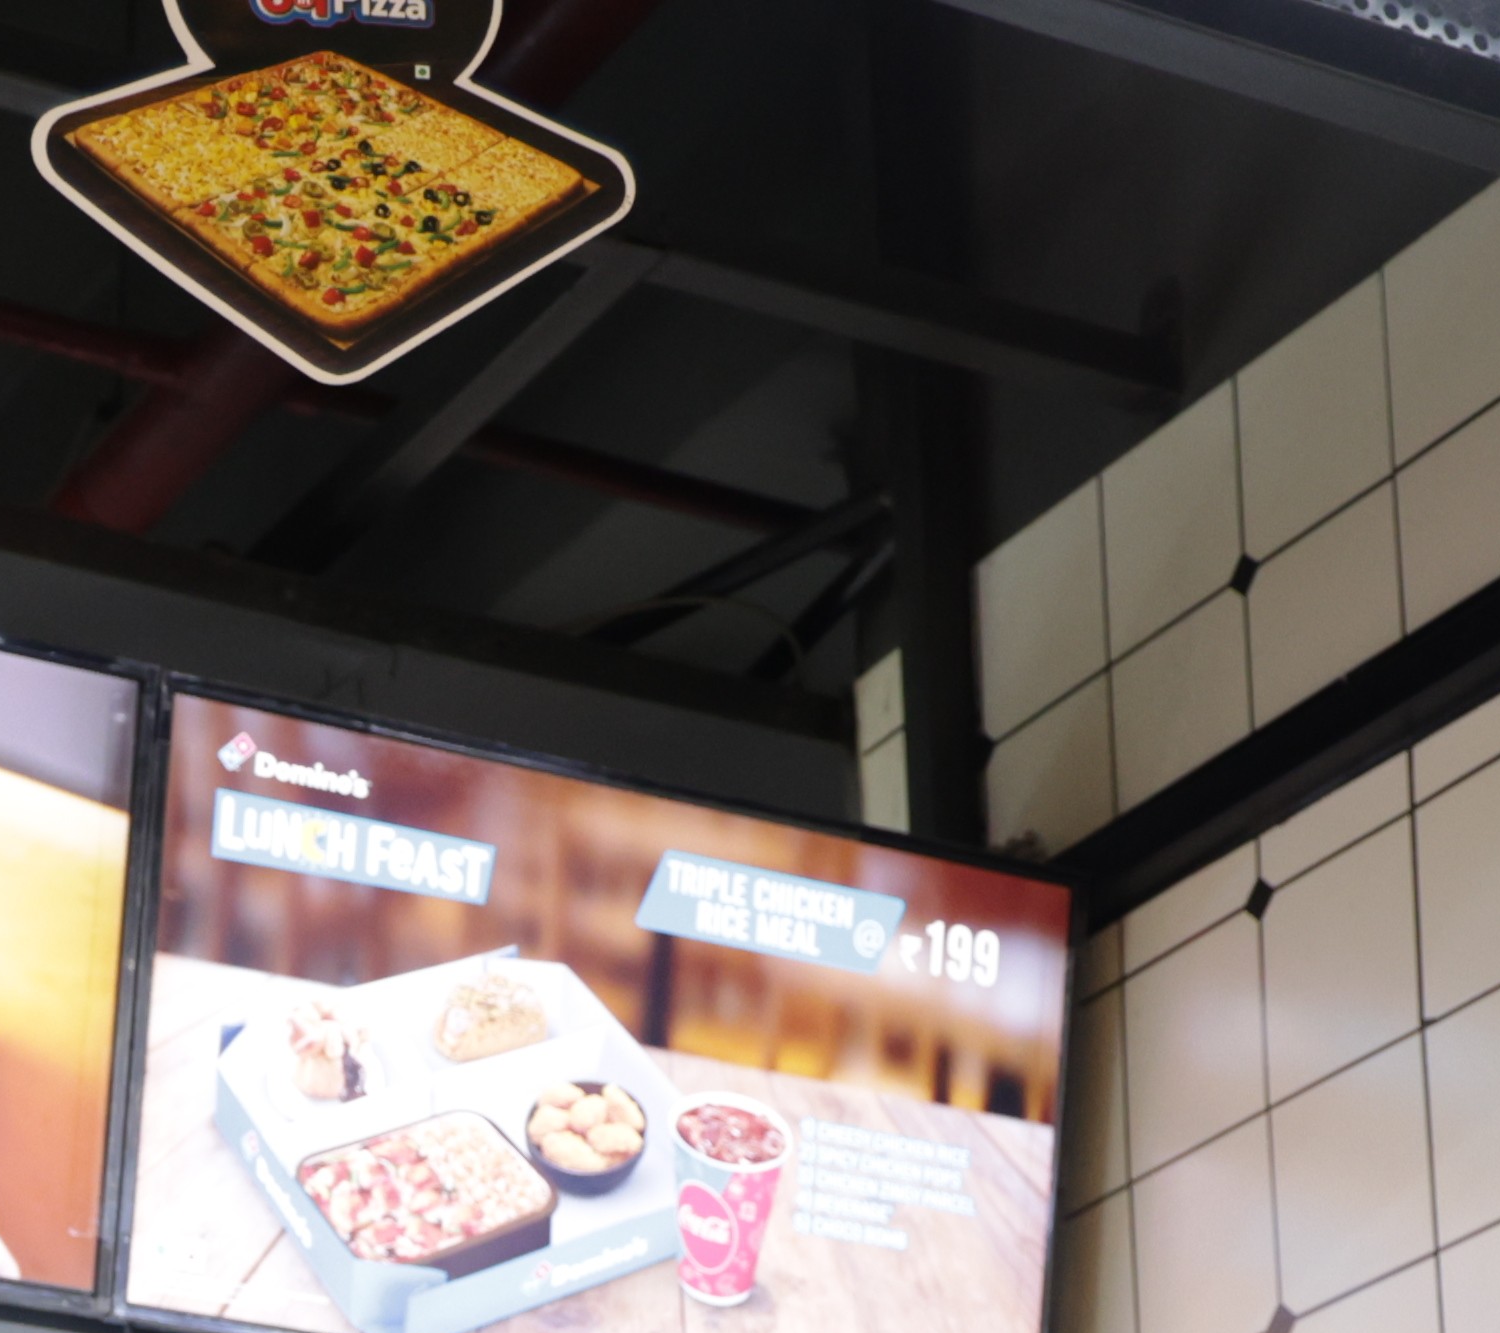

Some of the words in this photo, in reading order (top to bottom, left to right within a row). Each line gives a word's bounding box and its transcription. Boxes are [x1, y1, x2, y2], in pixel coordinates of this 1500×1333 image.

[254, 751, 372, 799] Domino's
[667, 859, 748, 906] TRIPLE
[753, 877, 855, 930] CHICKEN
[696, 901, 751, 942] RICE
[755, 913, 820, 957] MEAL
